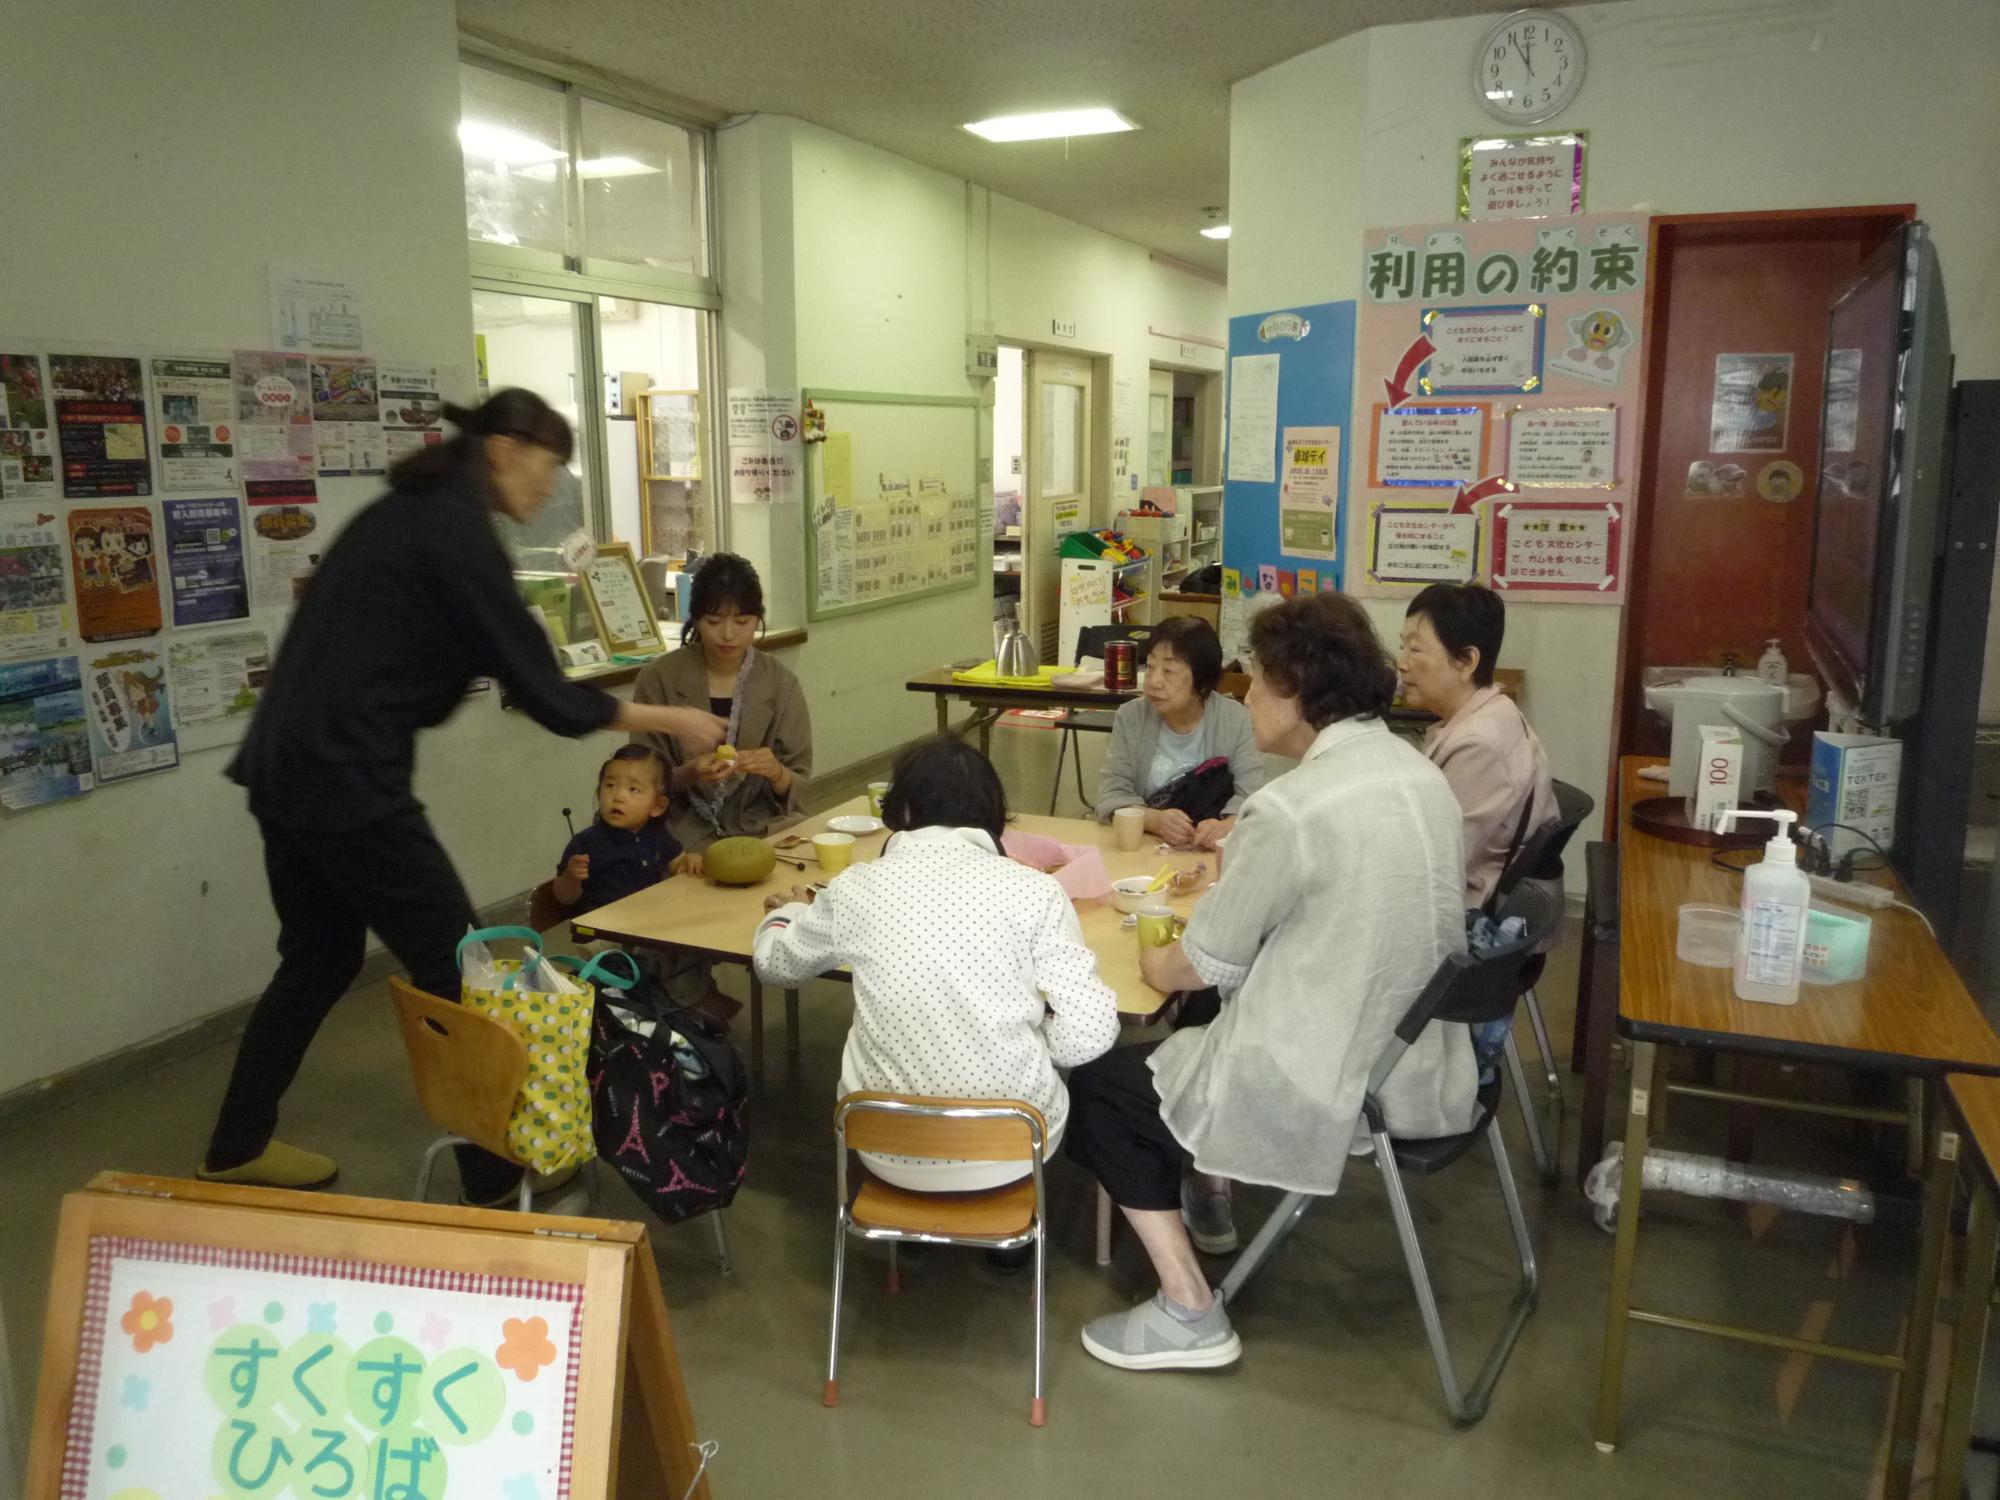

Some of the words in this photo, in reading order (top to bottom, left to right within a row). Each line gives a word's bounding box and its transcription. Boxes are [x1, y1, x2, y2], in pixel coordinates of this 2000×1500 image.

[1524, 25, 1536, 40] 12
[1545, 28, 1549, 42] 1
[1554, 39, 1564, 53] 2
[1494, 47, 1507, 61] 10
[1560, 55, 1569, 70] 3
[1490, 64, 1500, 78] 9
[1552, 73, 1562, 88] 4
[1542, 87, 1551, 102] 5
[1523, 95, 1533, 109] 6
[1480, 169, 1563, 182] よく過ごせるように
[1488, 183, 1553, 196] ルールを守って
[1368, 243, 1640, 299] 利用の約束
[1511, 539, 1602, 549] こども文化センター
[1709, 757, 1728, 785] 100
[212, 1337, 481, 1436] すくすく
[226, 1417, 440, 1500] ひろば
